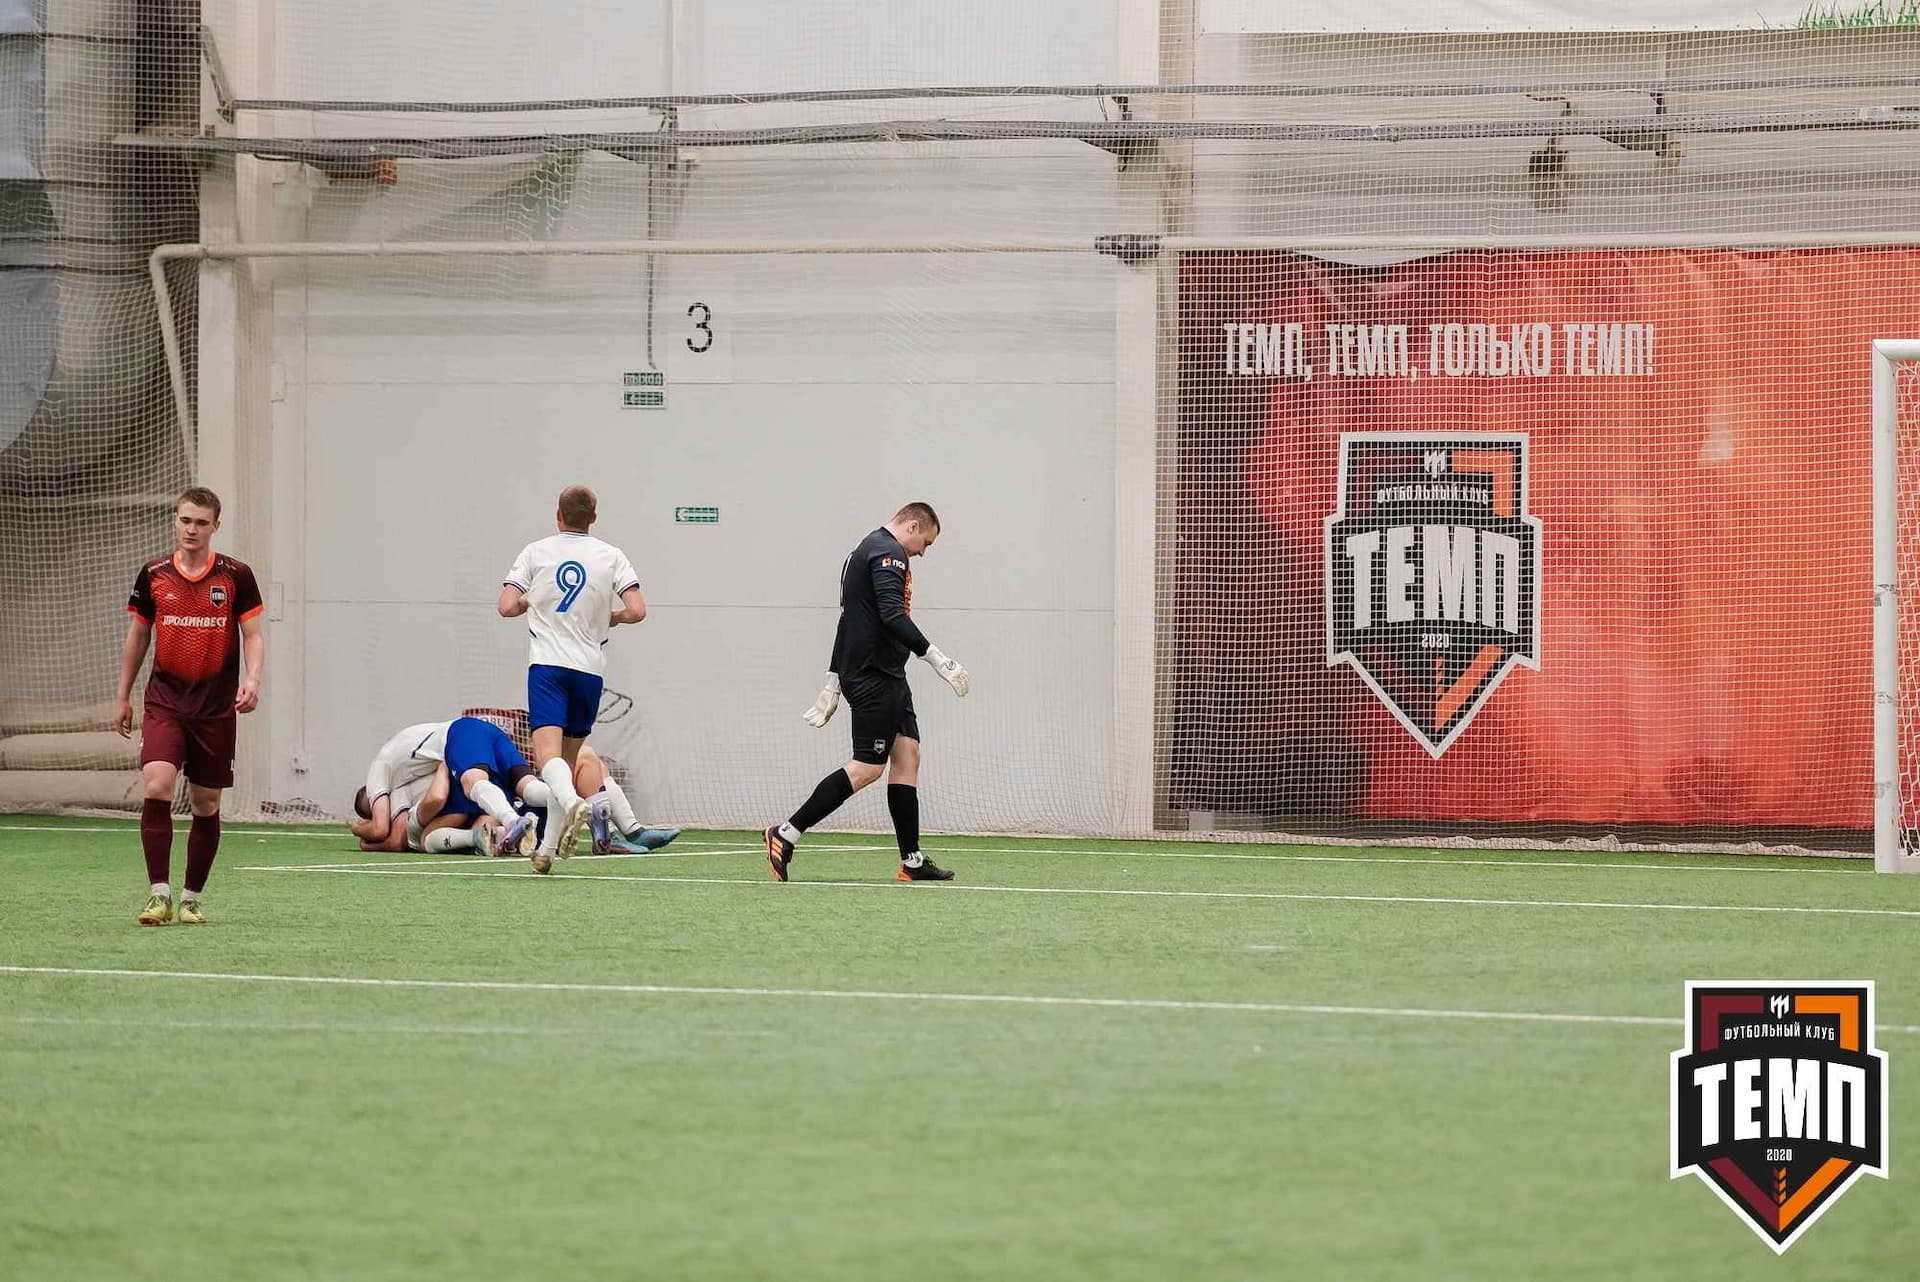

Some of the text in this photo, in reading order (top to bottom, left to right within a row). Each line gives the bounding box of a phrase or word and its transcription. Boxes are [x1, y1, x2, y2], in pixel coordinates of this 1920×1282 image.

[687, 302, 713, 353] 3
[1223, 323, 1654, 382] ТЕМП, ТЕМП, ТОЛЬКО ТЕМП!
[1376, 483, 1488, 504] ФУТБОЛЬНЫЙ КЛУБ
[556, 560, 587, 613] 9
[1346, 524, 1519, 634] ТЕМП
[1422, 633, 1450, 648] 2020
